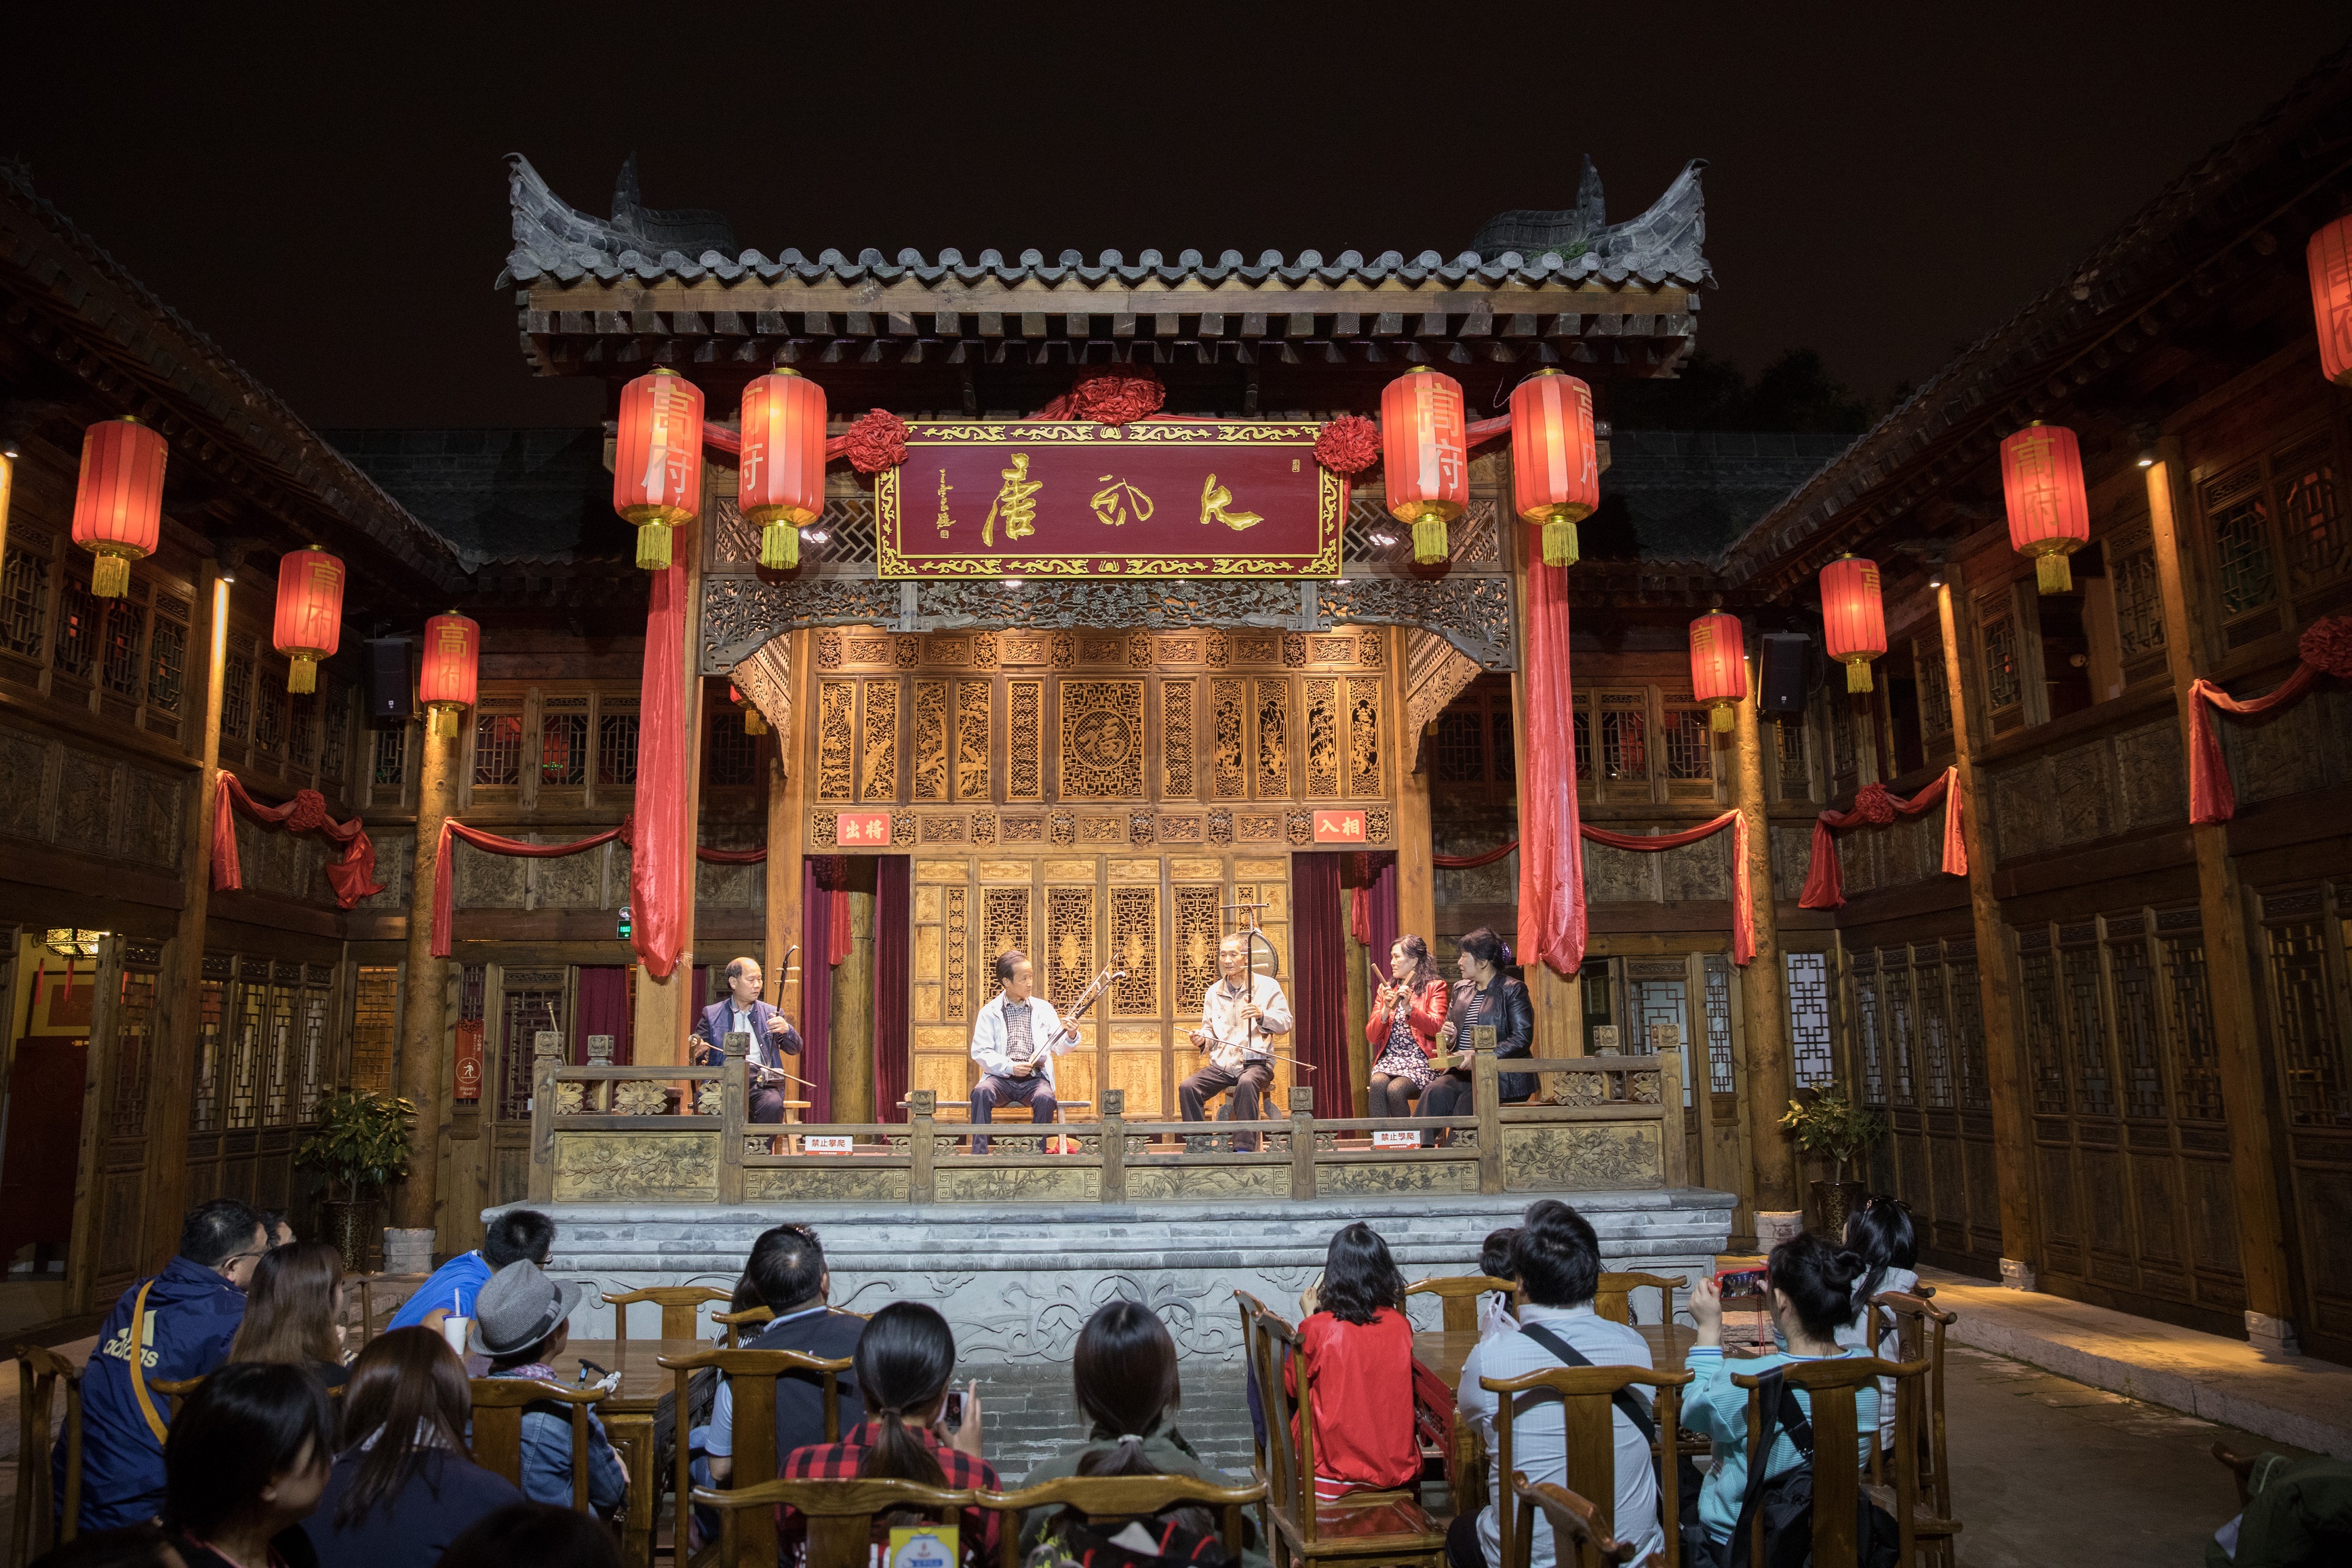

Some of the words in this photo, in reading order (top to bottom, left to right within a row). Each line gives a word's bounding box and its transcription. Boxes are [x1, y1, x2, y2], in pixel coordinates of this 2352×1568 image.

[641, 384, 694, 493] 高府
[1415, 383, 1463, 489] 高府
[2010, 436, 2062, 532] 高府
[300, 560, 341, 642] 高府
[846, 819, 884, 840] 出将
[1319, 817, 1360, 836] 入相
[811, 1139, 846, 1148] 禁止攀爬
[1381, 1132, 1415, 1141] 禁止攀爬
